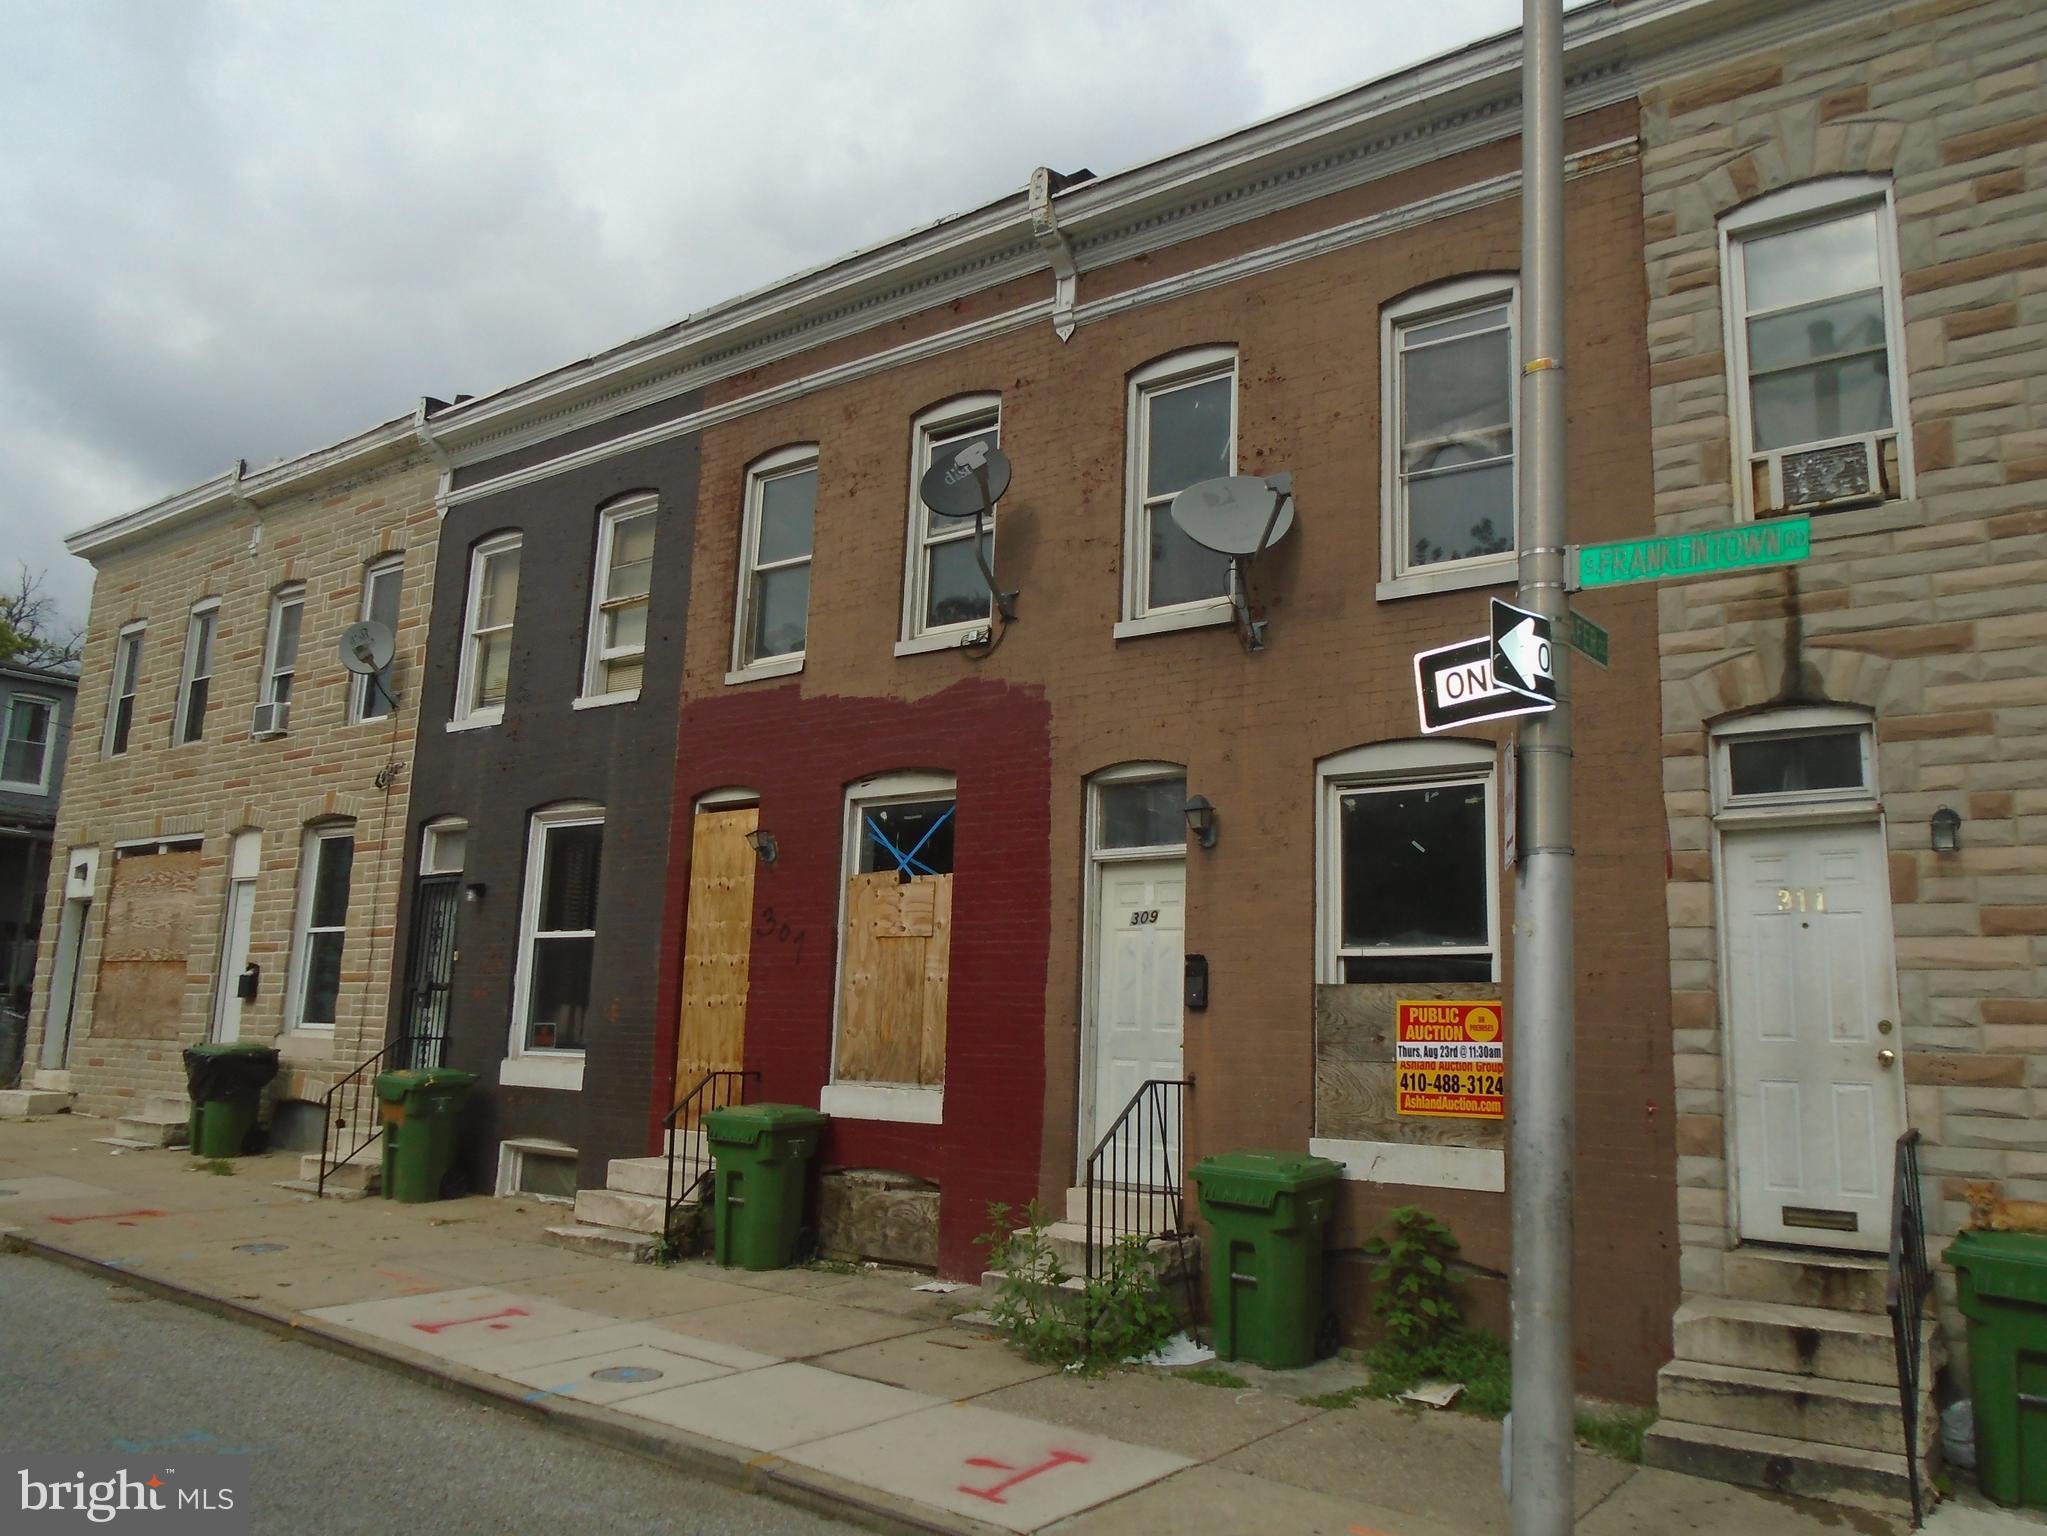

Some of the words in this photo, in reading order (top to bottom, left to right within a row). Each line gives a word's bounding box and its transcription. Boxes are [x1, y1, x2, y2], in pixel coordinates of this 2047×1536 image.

[1600, 526, 1781, 577] FRANKLINTOWN
[1784, 529, 1806, 548] RD
[1446, 664, 1500, 699] ON
[1130, 910, 1159, 926] 309
[1409, 1007, 1459, 1024] PUBLIC
[1406, 1025, 1463, 1041] AUCTION
[1398, 1045, 1423, 1059] Thurs,
[1423, 1045, 1438, 1060] Aug
[1440, 1045, 1458, 1058] 23rd
[1468, 1046, 1501, 1059] 11:30am
[1400, 1072, 1504, 1096] 410-488-3124
[1404, 1094, 1501, 1113] AshlandAuction.com
